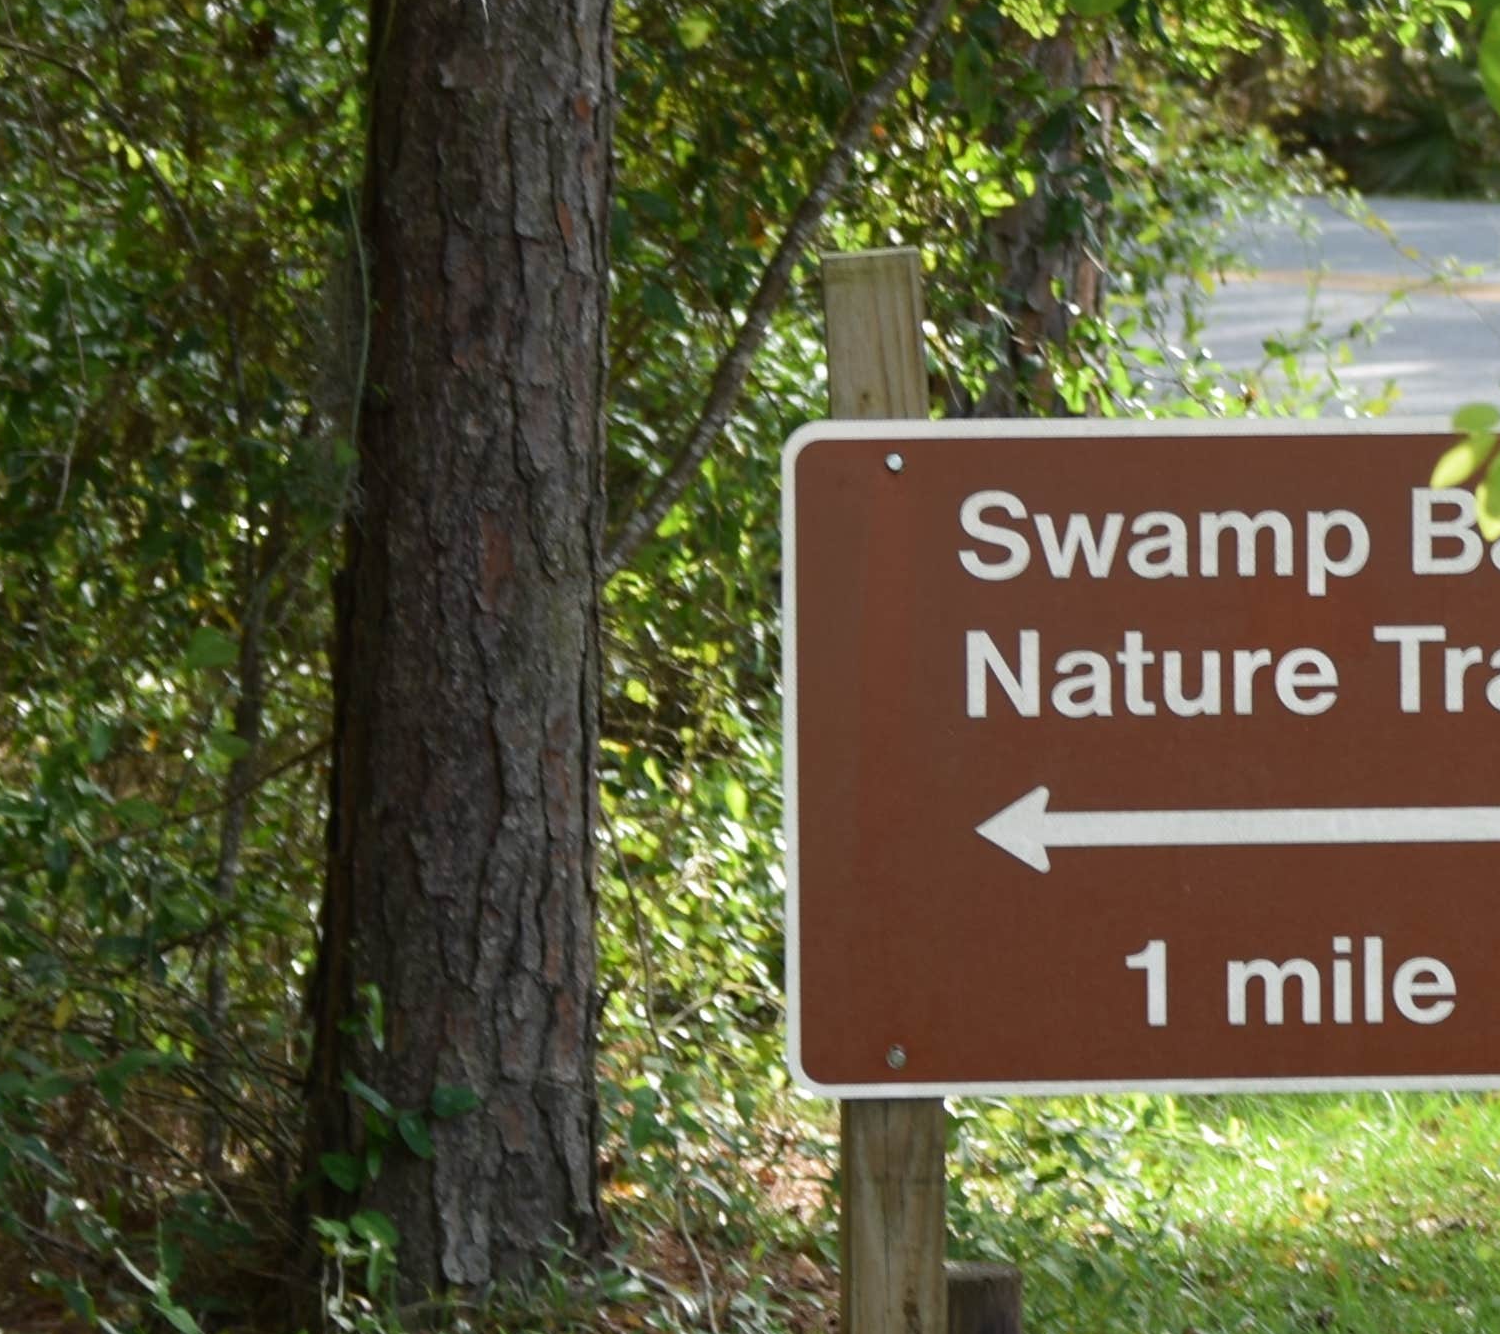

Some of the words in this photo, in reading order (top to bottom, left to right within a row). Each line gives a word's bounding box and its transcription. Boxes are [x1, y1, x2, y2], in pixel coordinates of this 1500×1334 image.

[958, 489, 1370, 597] Swamp
[965, 629, 1339, 718] Nature
[1124, 939, 1168, 1027] 1
[1227, 936, 1457, 1026] mile
